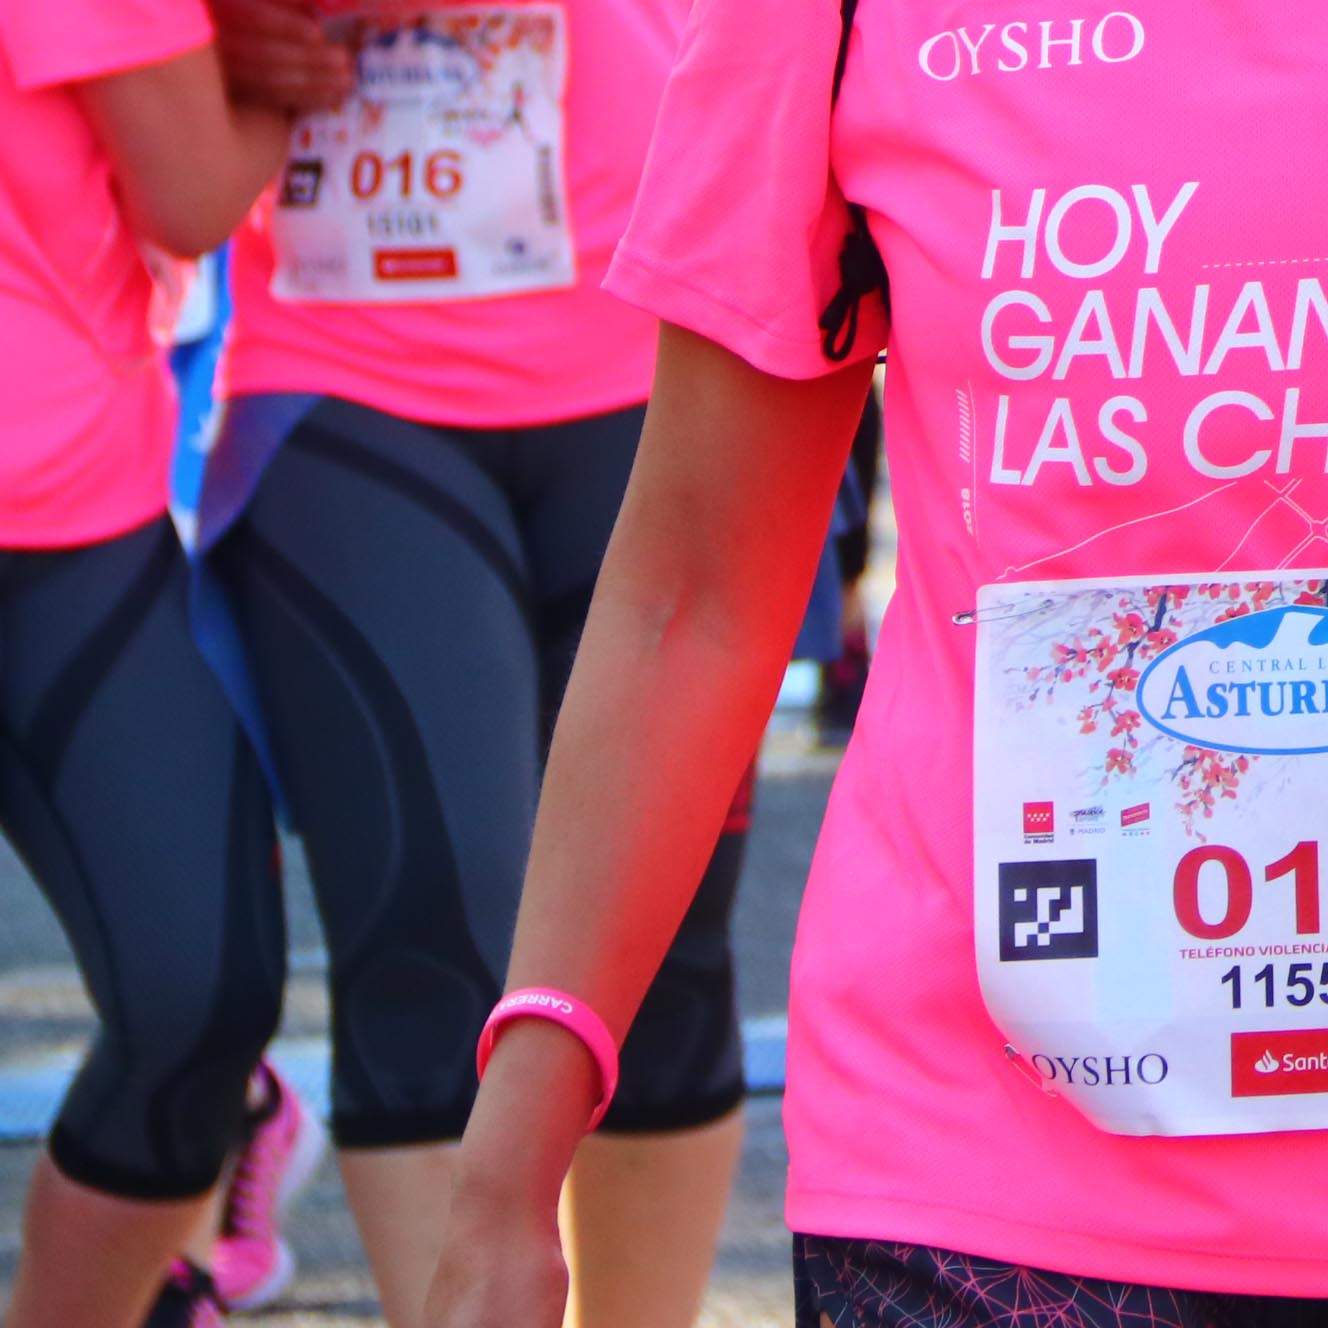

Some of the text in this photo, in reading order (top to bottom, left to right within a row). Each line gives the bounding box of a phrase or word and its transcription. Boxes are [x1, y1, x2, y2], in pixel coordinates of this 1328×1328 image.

[918, 10, 1146, 82] OYSHO
[351, 148, 464, 201] 016
[980, 180, 1200, 280] HOY
[989, 386, 1149, 487] LAS
[1208, 655, 1308, 674] CENTRAL
[1178, 944, 1256, 960] TELÉFONO
[1031, 1052, 1169, 1087] OYSHO
